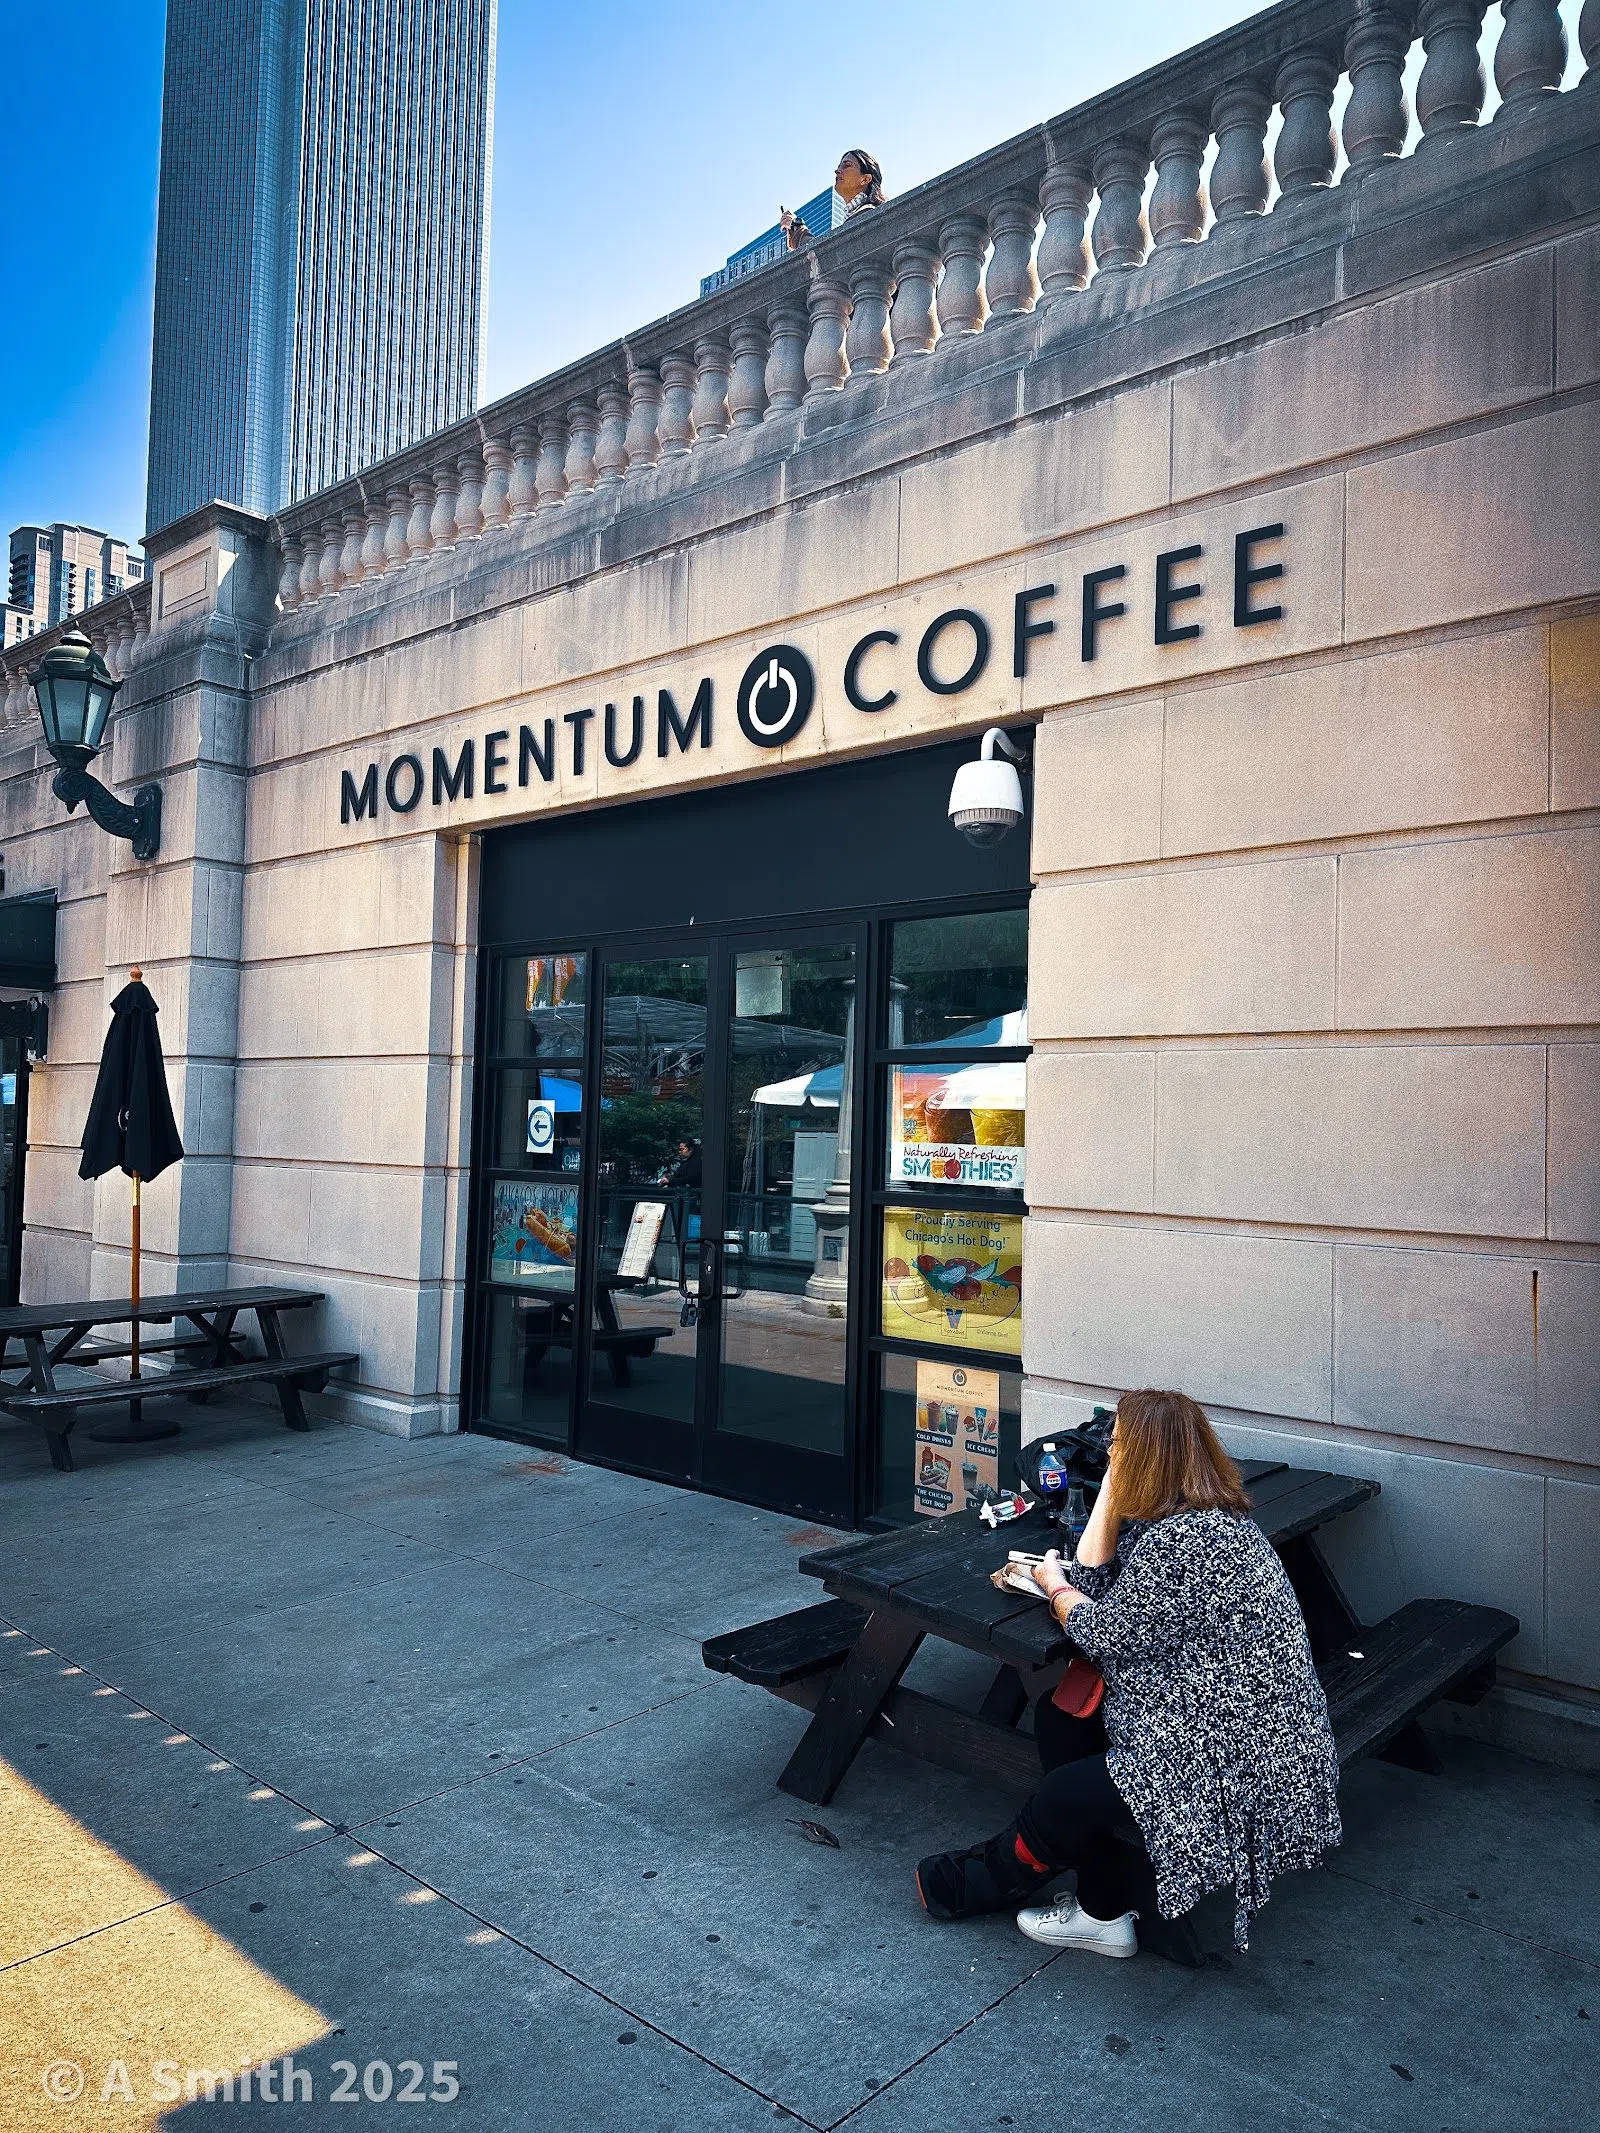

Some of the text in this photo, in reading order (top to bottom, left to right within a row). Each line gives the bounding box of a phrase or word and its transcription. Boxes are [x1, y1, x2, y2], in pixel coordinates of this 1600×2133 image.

[340, 522, 1285, 825] MOMENTUM COFFEE
[903, 1144, 1019, 1167] Naturally Refreshing
[902, 1157, 1014, 1182] SMOOTHIES
[914, 1213, 1001, 1233] Proudly Serving
[905, 1229, 954, 1244] Chicago's
[957, 1234, 977, 1247] Hot
[936, 1385, 964, 1394] MOMENTUM
[916, 1432, 952, 1445] COLD DRINKS
[967, 1442, 996, 1454] ICE CREAM
[916, 1488, 952, 1501] THE CHICAGO
[922, 1498, 946, 1509] HOT DOG
